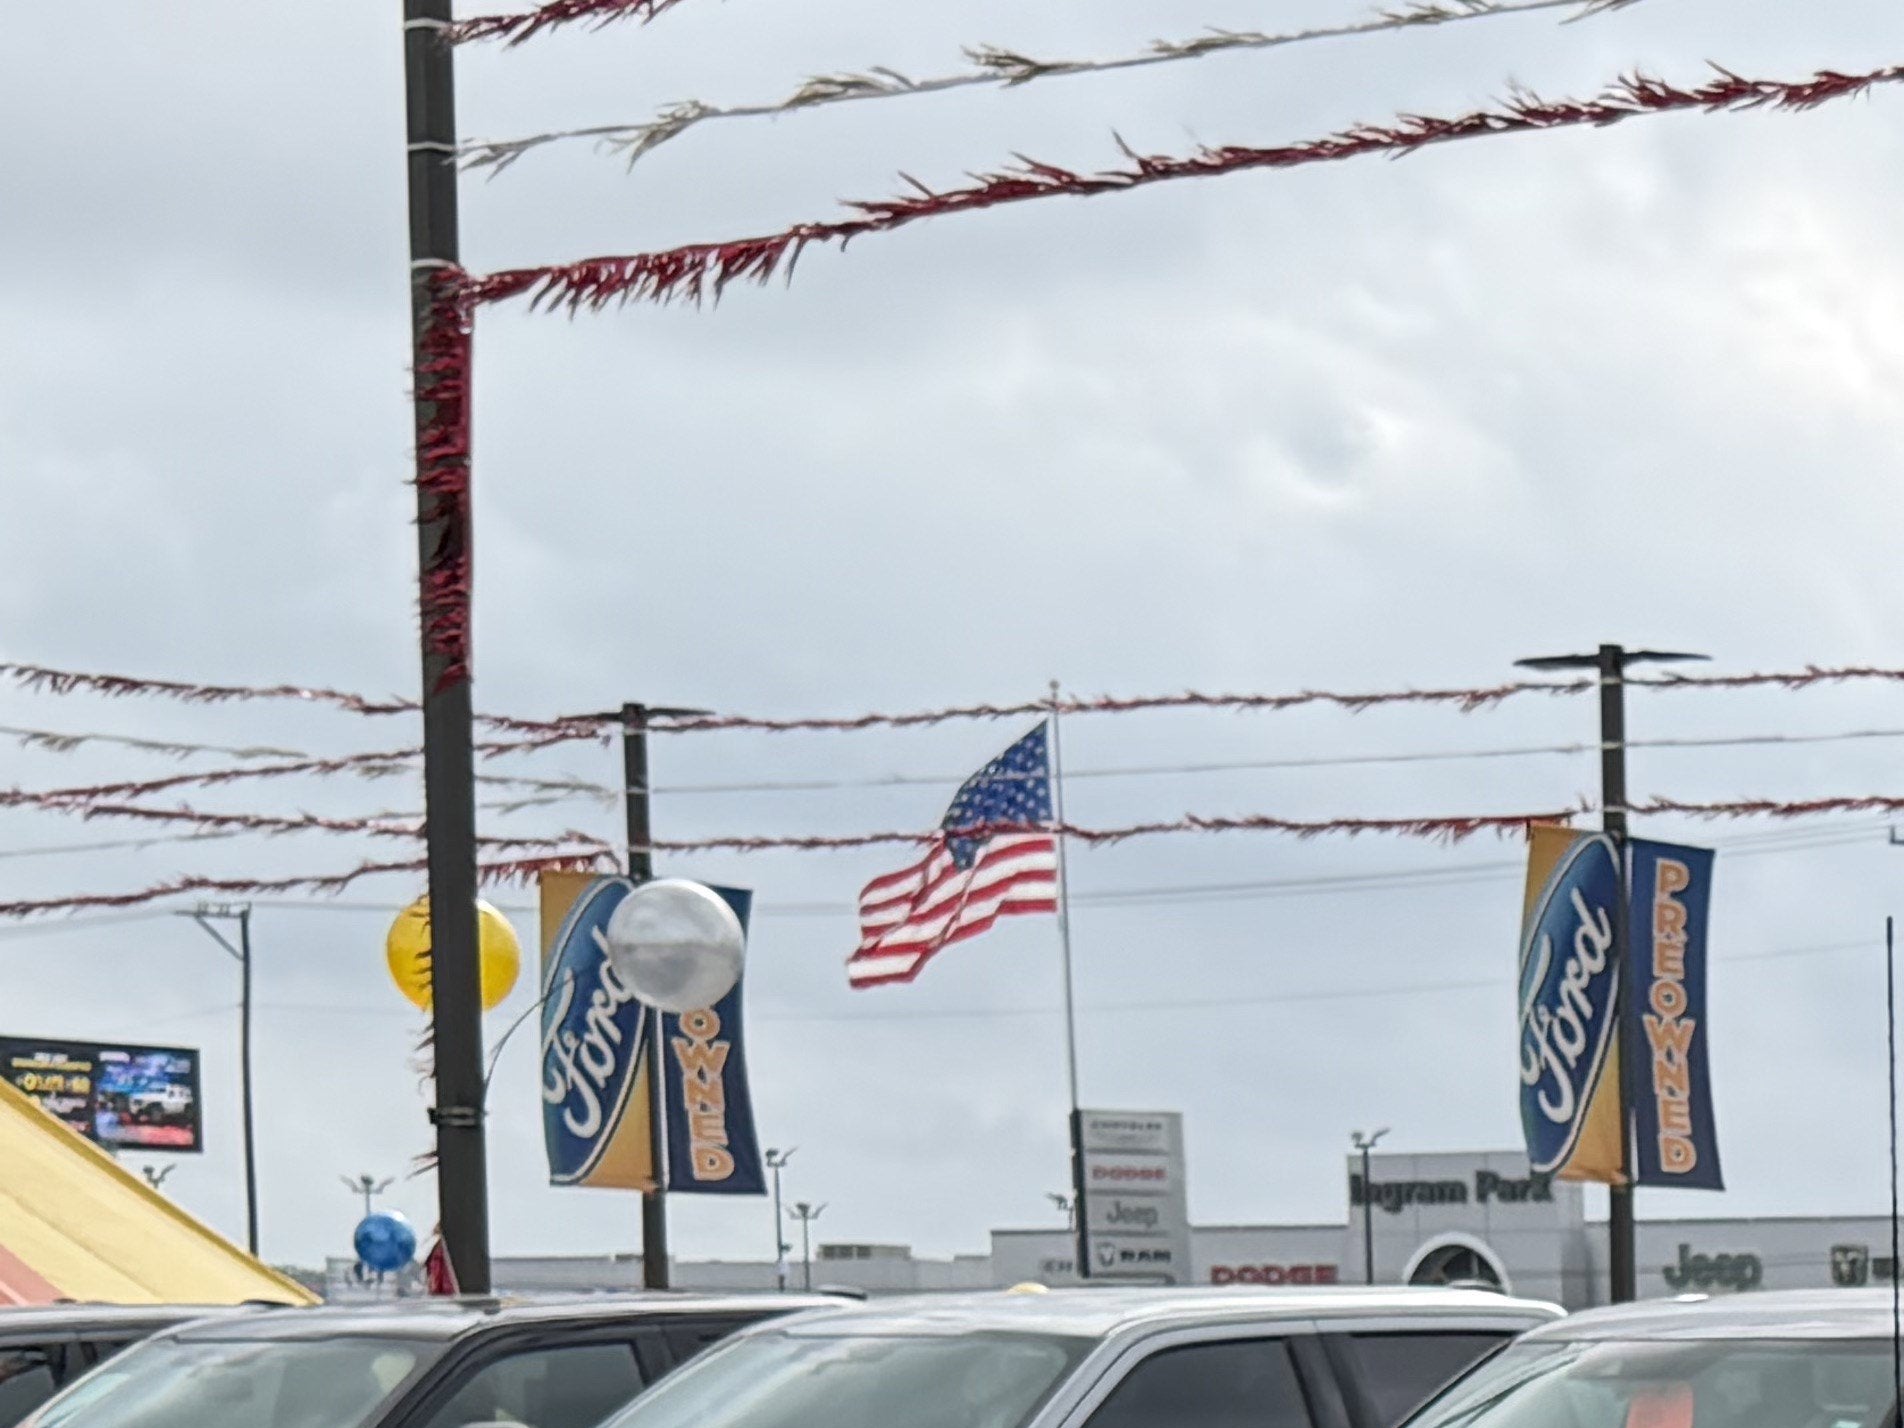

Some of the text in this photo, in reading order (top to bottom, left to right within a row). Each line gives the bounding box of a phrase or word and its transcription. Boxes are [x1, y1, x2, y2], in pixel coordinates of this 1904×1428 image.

[1519, 887, 1612, 1122] Ford
[671, 1006, 734, 1181] OWNED
[1092, 1165, 1167, 1180] DODGE
[1349, 1169, 1554, 1213] Ingram Park
[1107, 1201, 1159, 1227] Jeep
[1120, 1250, 1171, 1263] RAM
[1663, 1243, 1762, 1290] Jeep
[1211, 1265, 1338, 1285] DODGE
